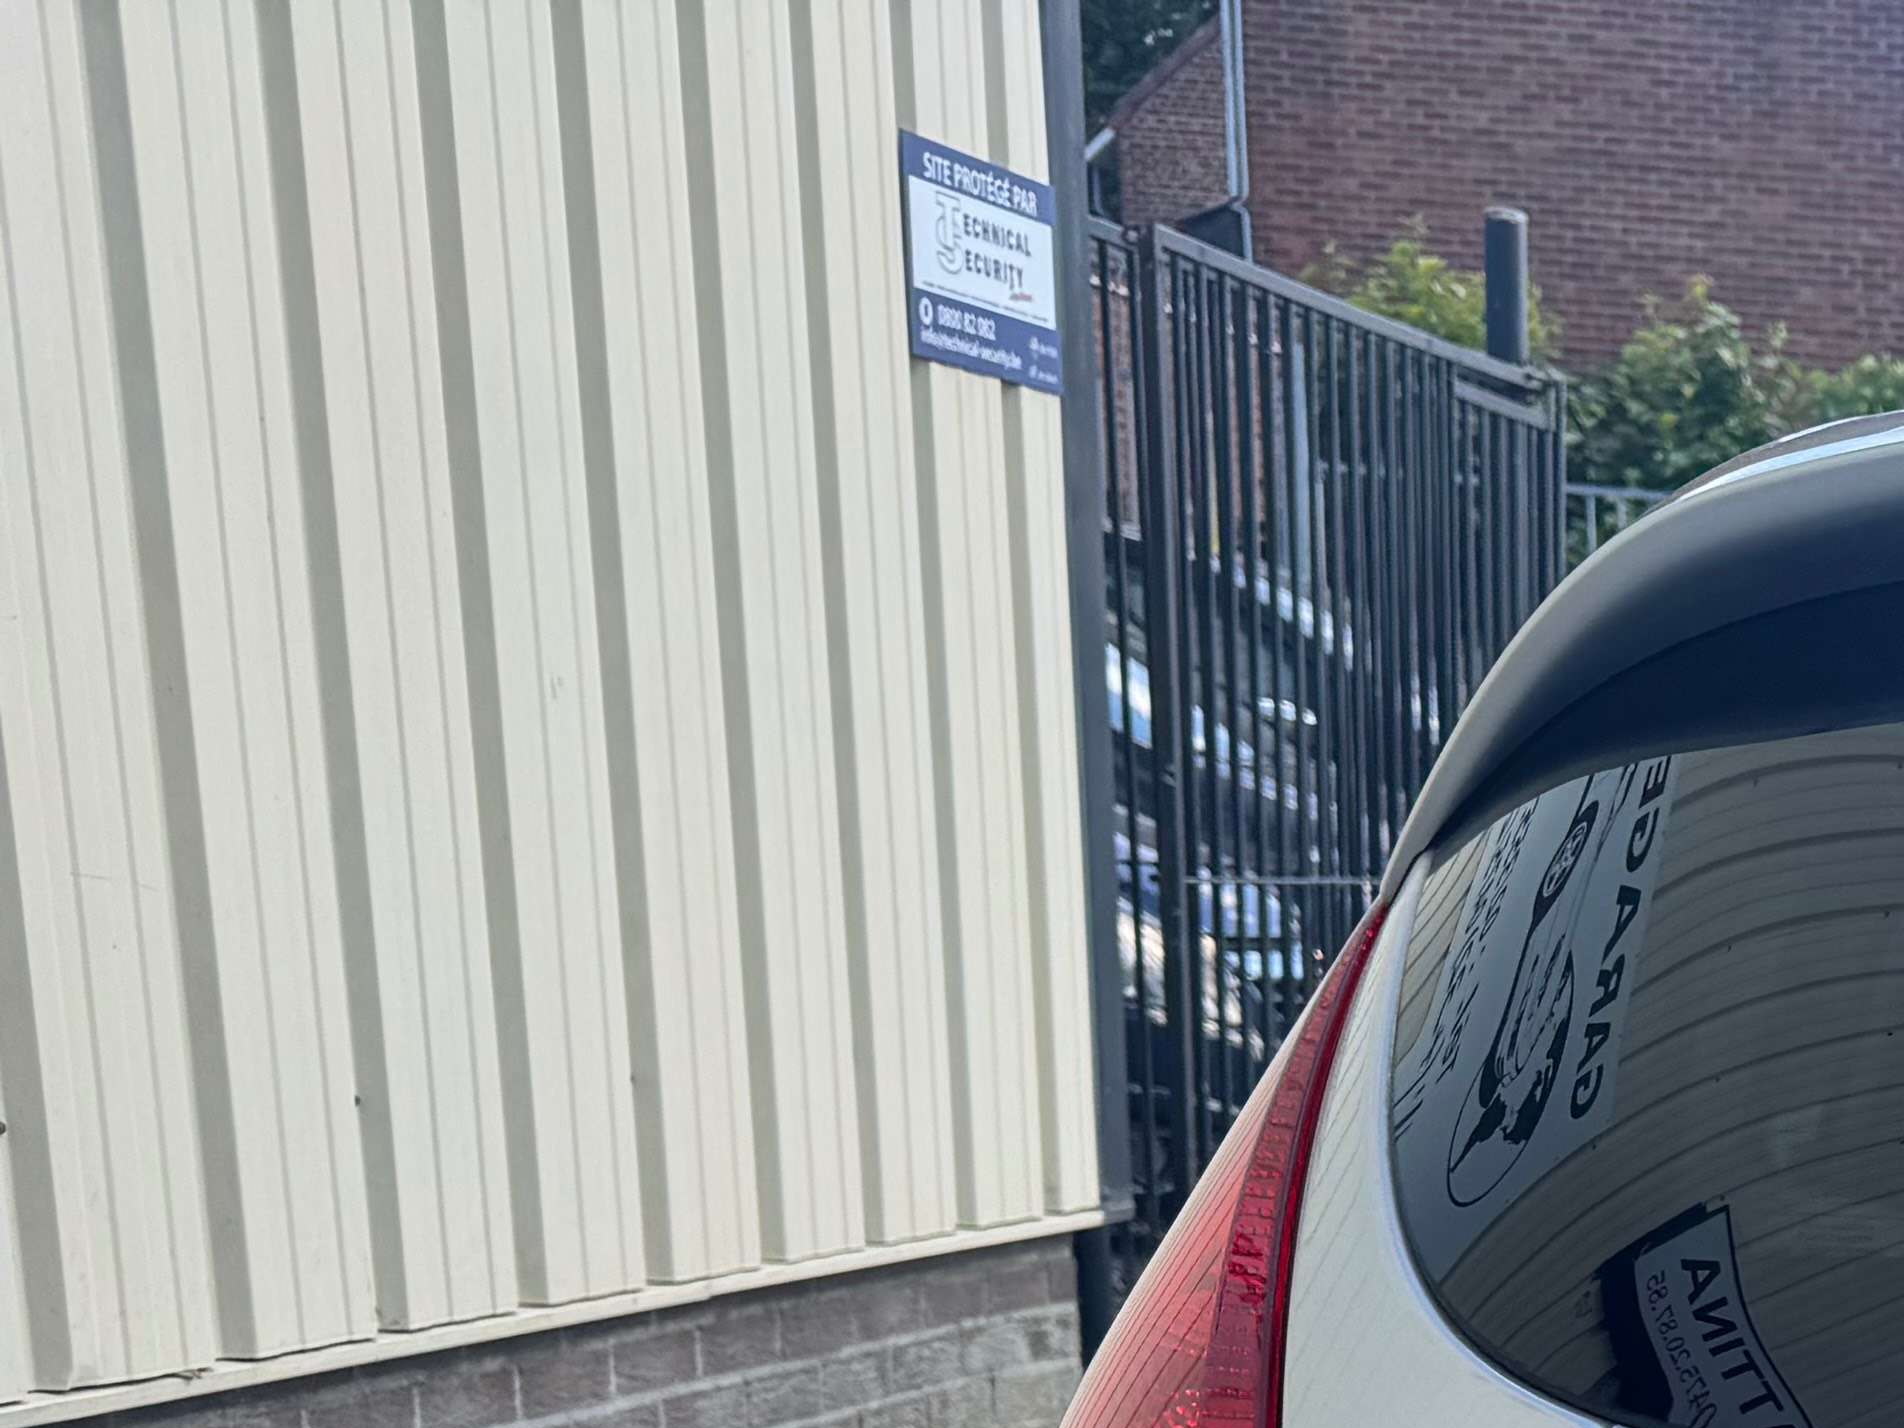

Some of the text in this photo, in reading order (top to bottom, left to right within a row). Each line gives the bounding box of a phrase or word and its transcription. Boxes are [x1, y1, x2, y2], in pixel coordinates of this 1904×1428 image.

[923, 152, 1037, 217] SITE PROTÉGÉ PAR
